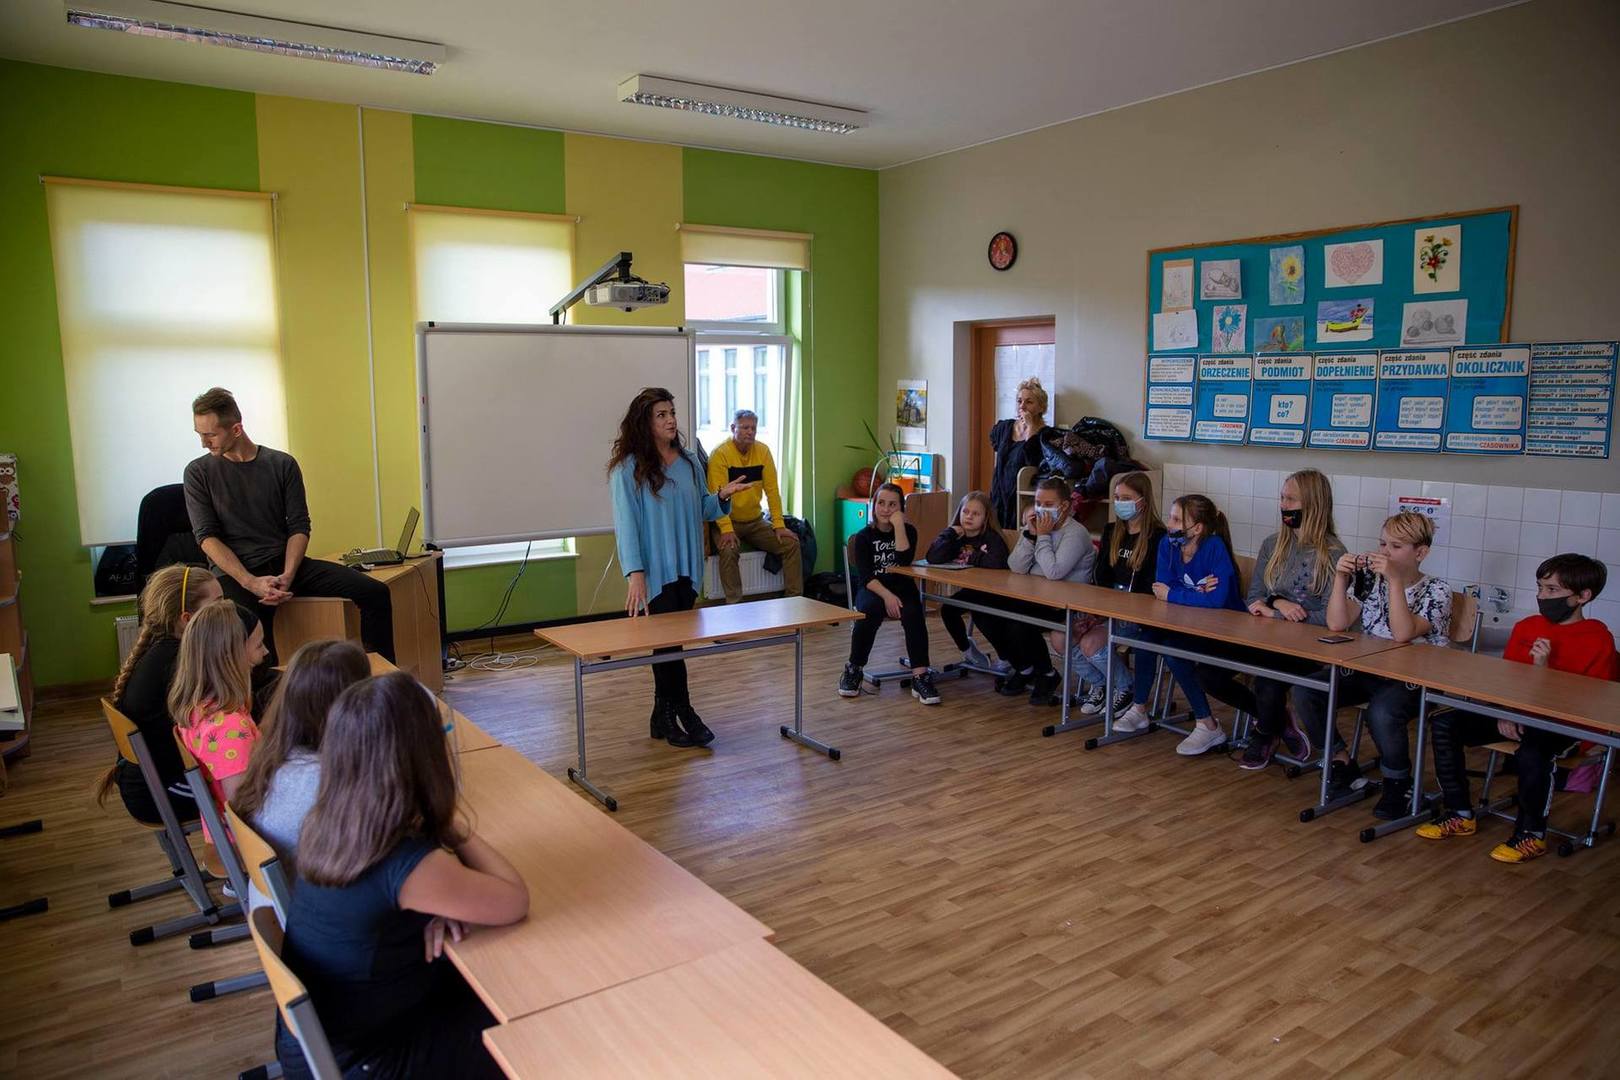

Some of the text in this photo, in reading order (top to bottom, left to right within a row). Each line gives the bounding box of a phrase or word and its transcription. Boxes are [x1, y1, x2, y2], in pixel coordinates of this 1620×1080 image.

[1457, 352, 1477, 360] część
[1262, 367, 1304, 377] PODMIOT
[1316, 366, 1374, 376] DOPEŁNIENIE
[1382, 364, 1447, 376] PRZYDAWKA
[1456, 361, 1525, 374] OKOLICZNIK
[1202, 368, 1249, 377] ORZECZENIE
[1278, 400, 1294, 409] kto?
[1277, 410, 1289, 418] co?
